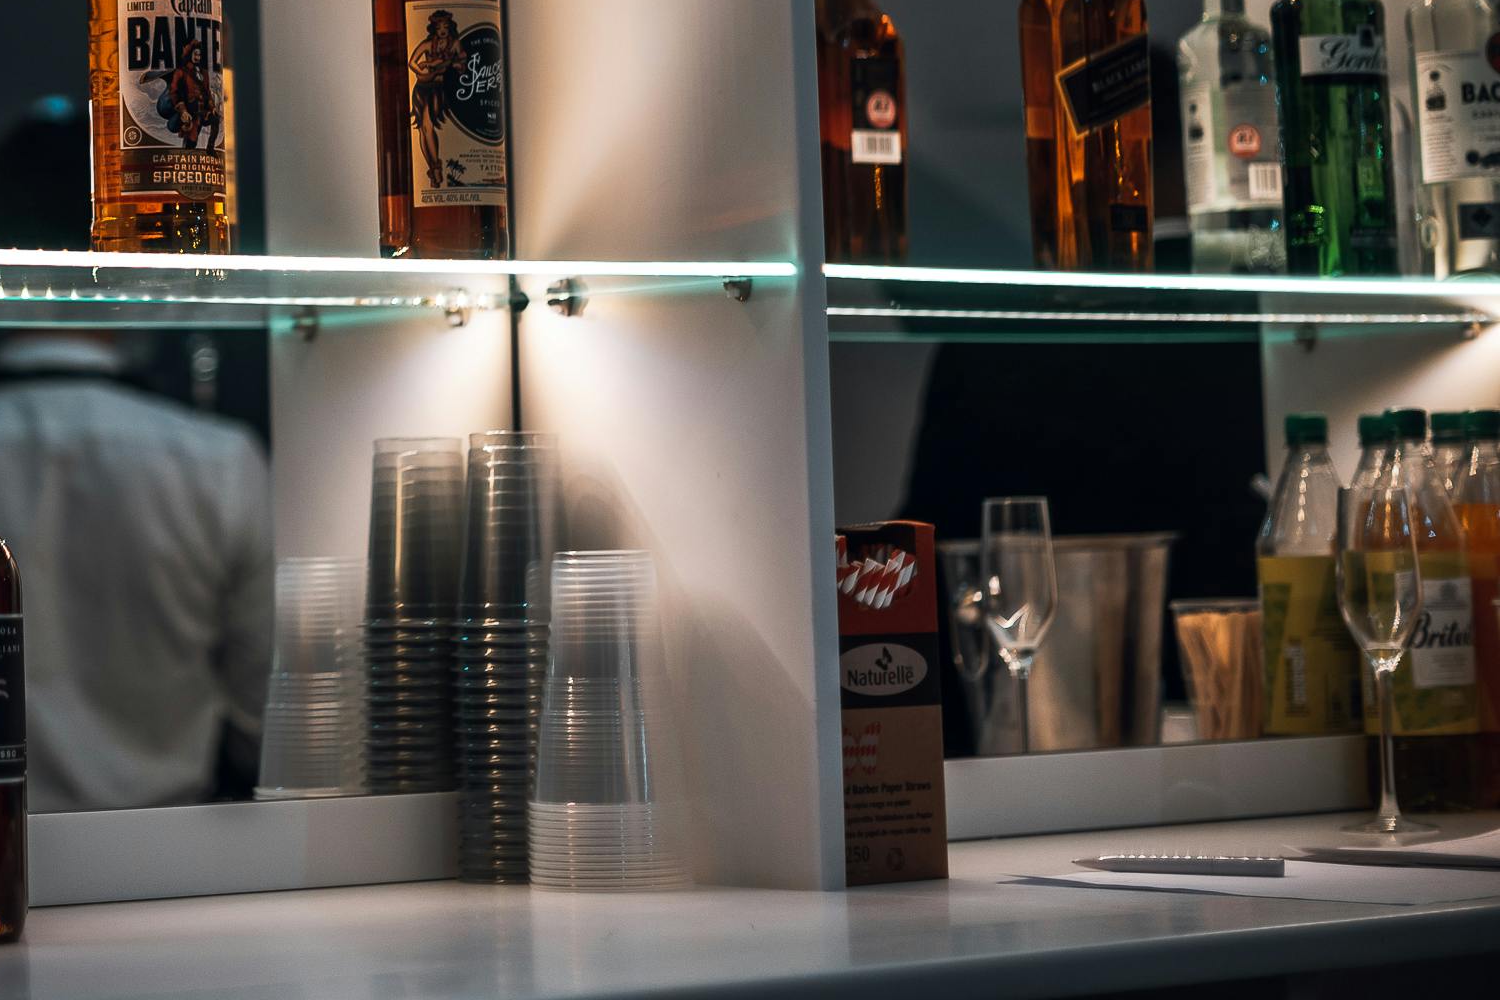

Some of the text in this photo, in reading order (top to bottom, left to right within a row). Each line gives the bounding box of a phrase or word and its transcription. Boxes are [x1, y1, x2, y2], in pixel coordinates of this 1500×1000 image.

[127, 1, 155, 12] LIMITED
[153, 154, 197, 163] CAPTAIN
[174, 163, 215, 172] ORIGINAL
[481, 164, 503, 172] TATTO
[153, 171, 202, 183] SPICED
[205, 172, 225, 185] GOLD
